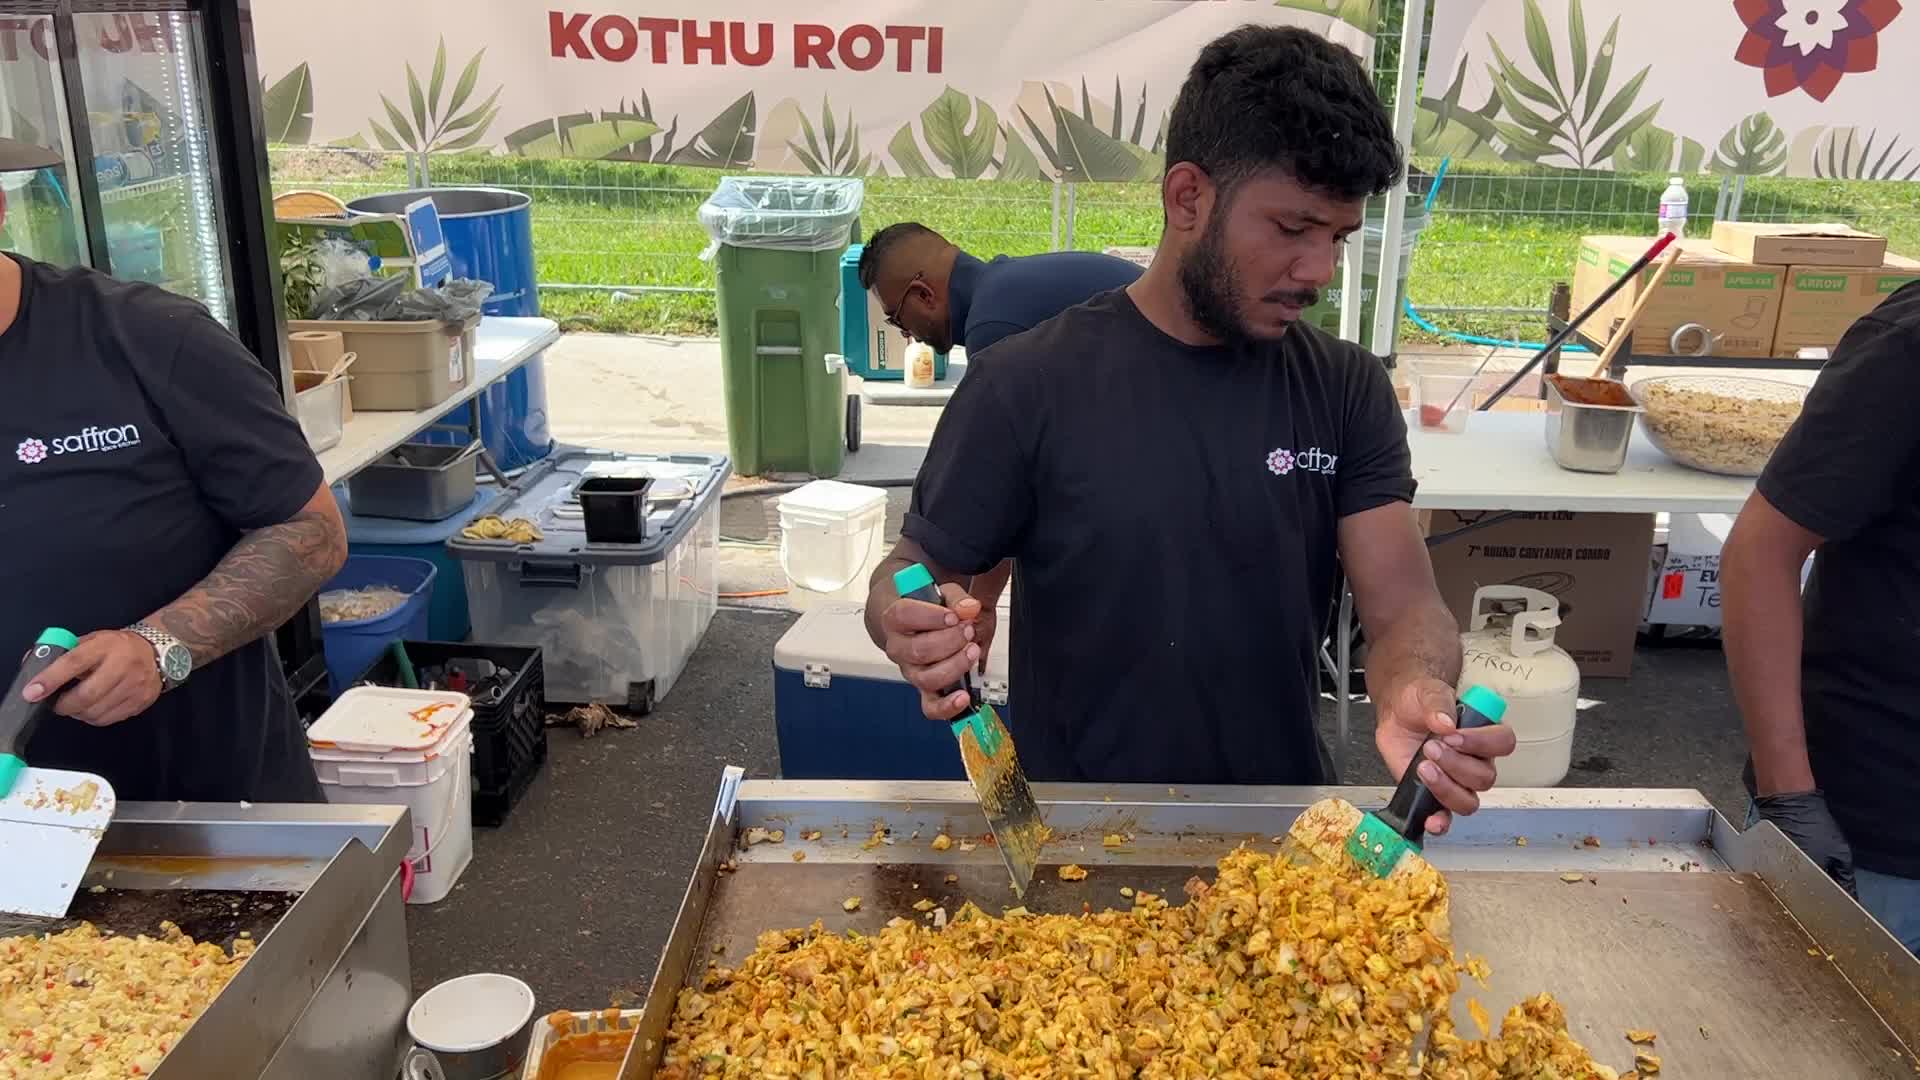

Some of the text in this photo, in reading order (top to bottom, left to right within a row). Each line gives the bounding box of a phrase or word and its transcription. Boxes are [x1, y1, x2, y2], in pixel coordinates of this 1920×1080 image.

[548, 11, 944, 74] KOTHU ROTI
[1799, 278, 1845, 289] ARROW
[51, 424, 140, 455] saffron
[1483, 545, 1517, 558] ROUND
[1519, 546, 1573, 560] CONTAINER
[1700, 570, 1721, 583] EV
[1696, 586, 1721, 608] Te
[1464, 649, 1534, 680] FFRON
